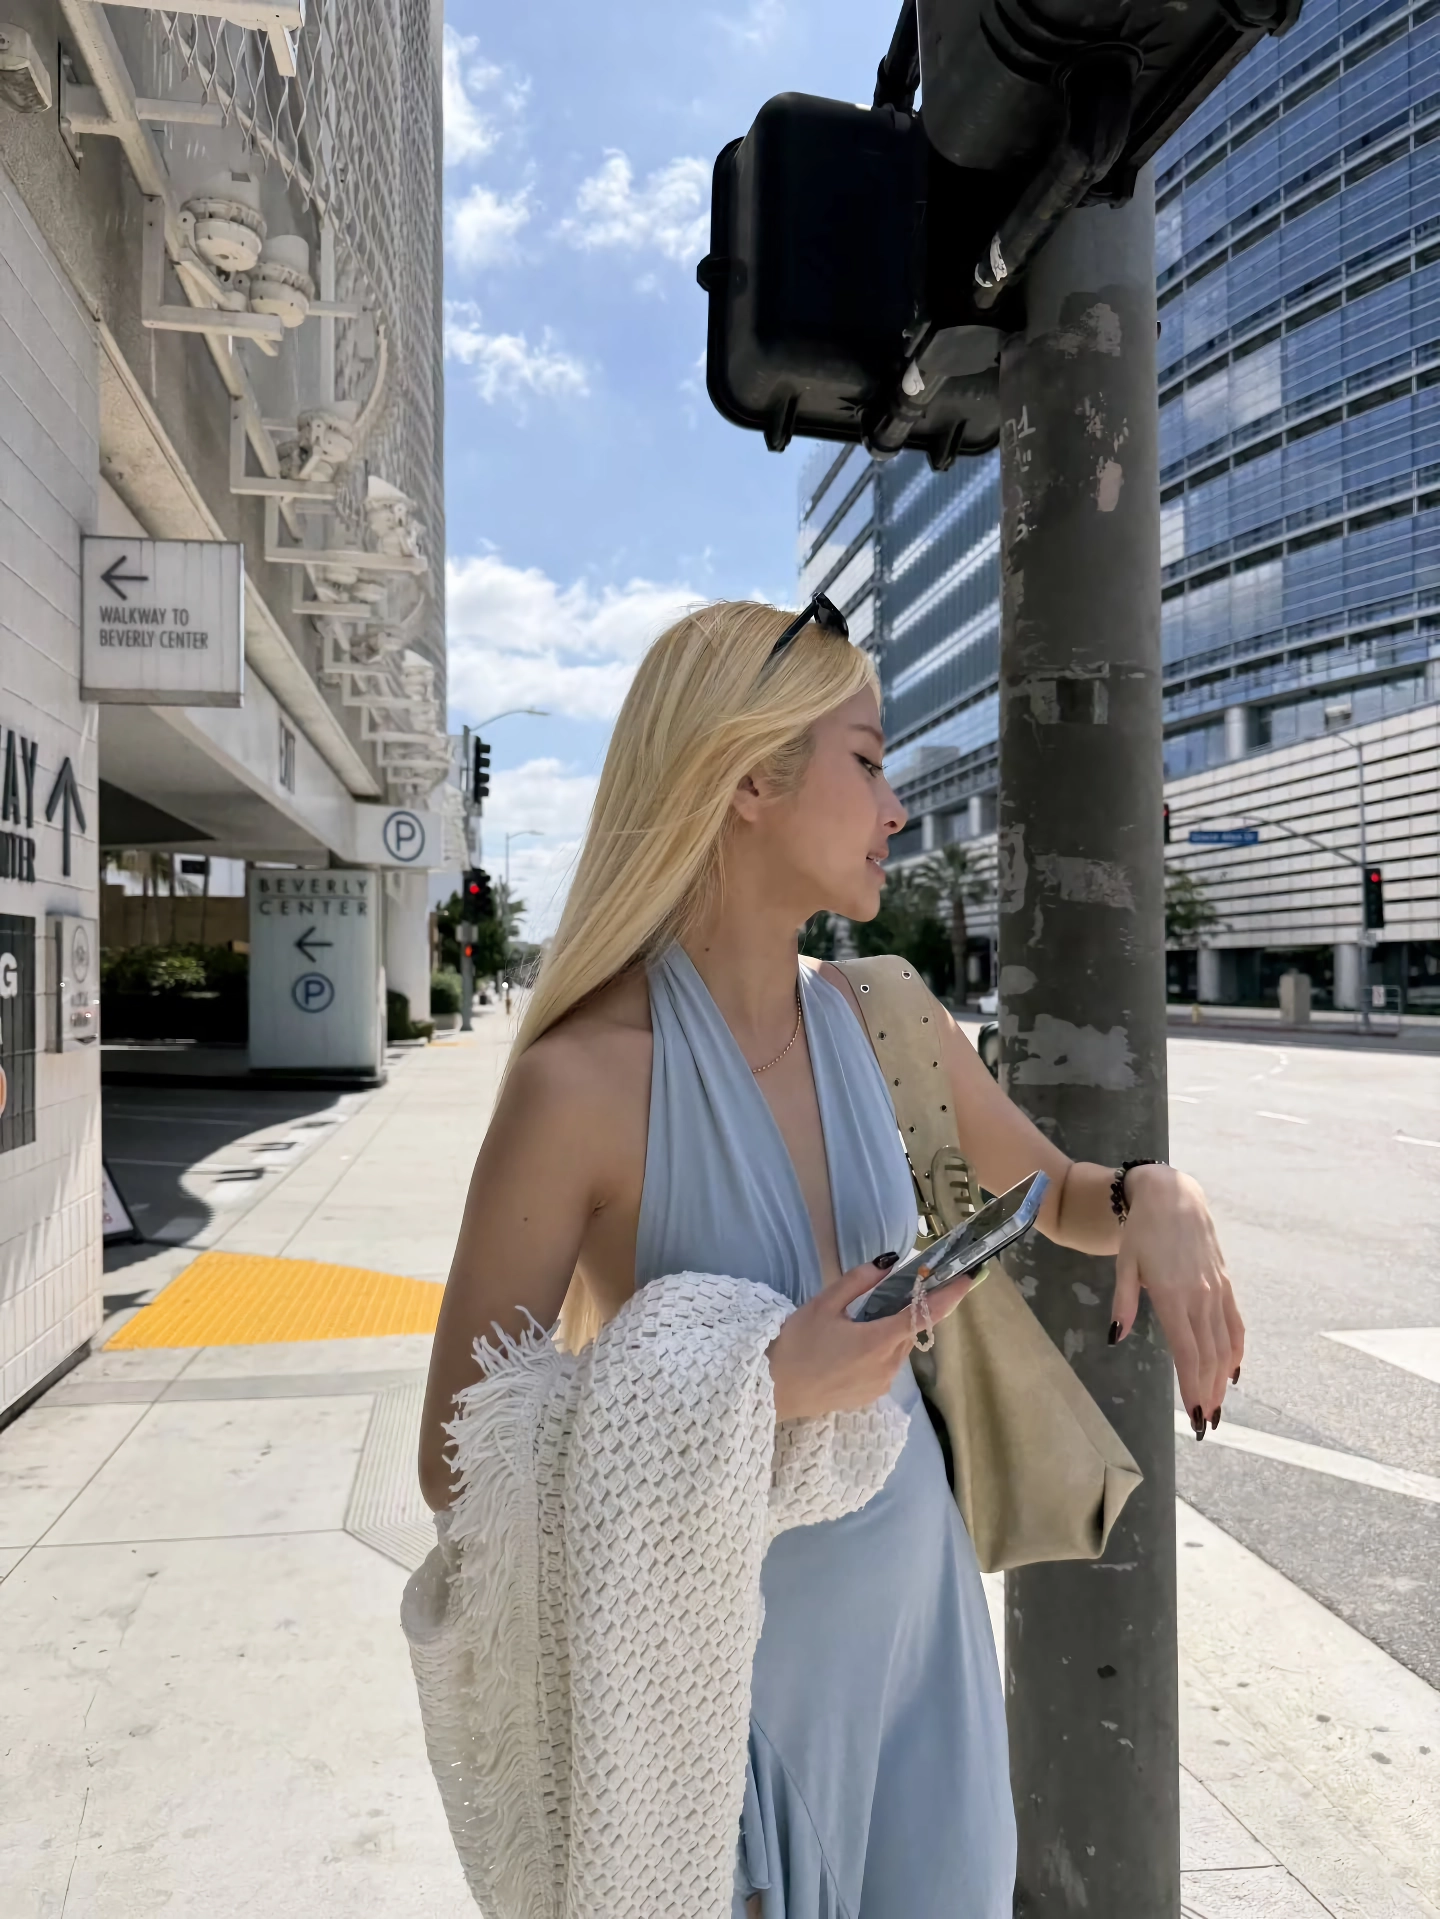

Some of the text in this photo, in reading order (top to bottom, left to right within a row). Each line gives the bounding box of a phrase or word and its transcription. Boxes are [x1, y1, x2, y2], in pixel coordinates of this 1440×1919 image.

[99, 606, 190, 627] WALKWAY TO
[99, 629, 209, 650] BEVERLY CENTER
[0, 725, 38, 829] AY
[258, 878, 368, 895] BEVERLY
[259, 900, 368, 916] CENTER
